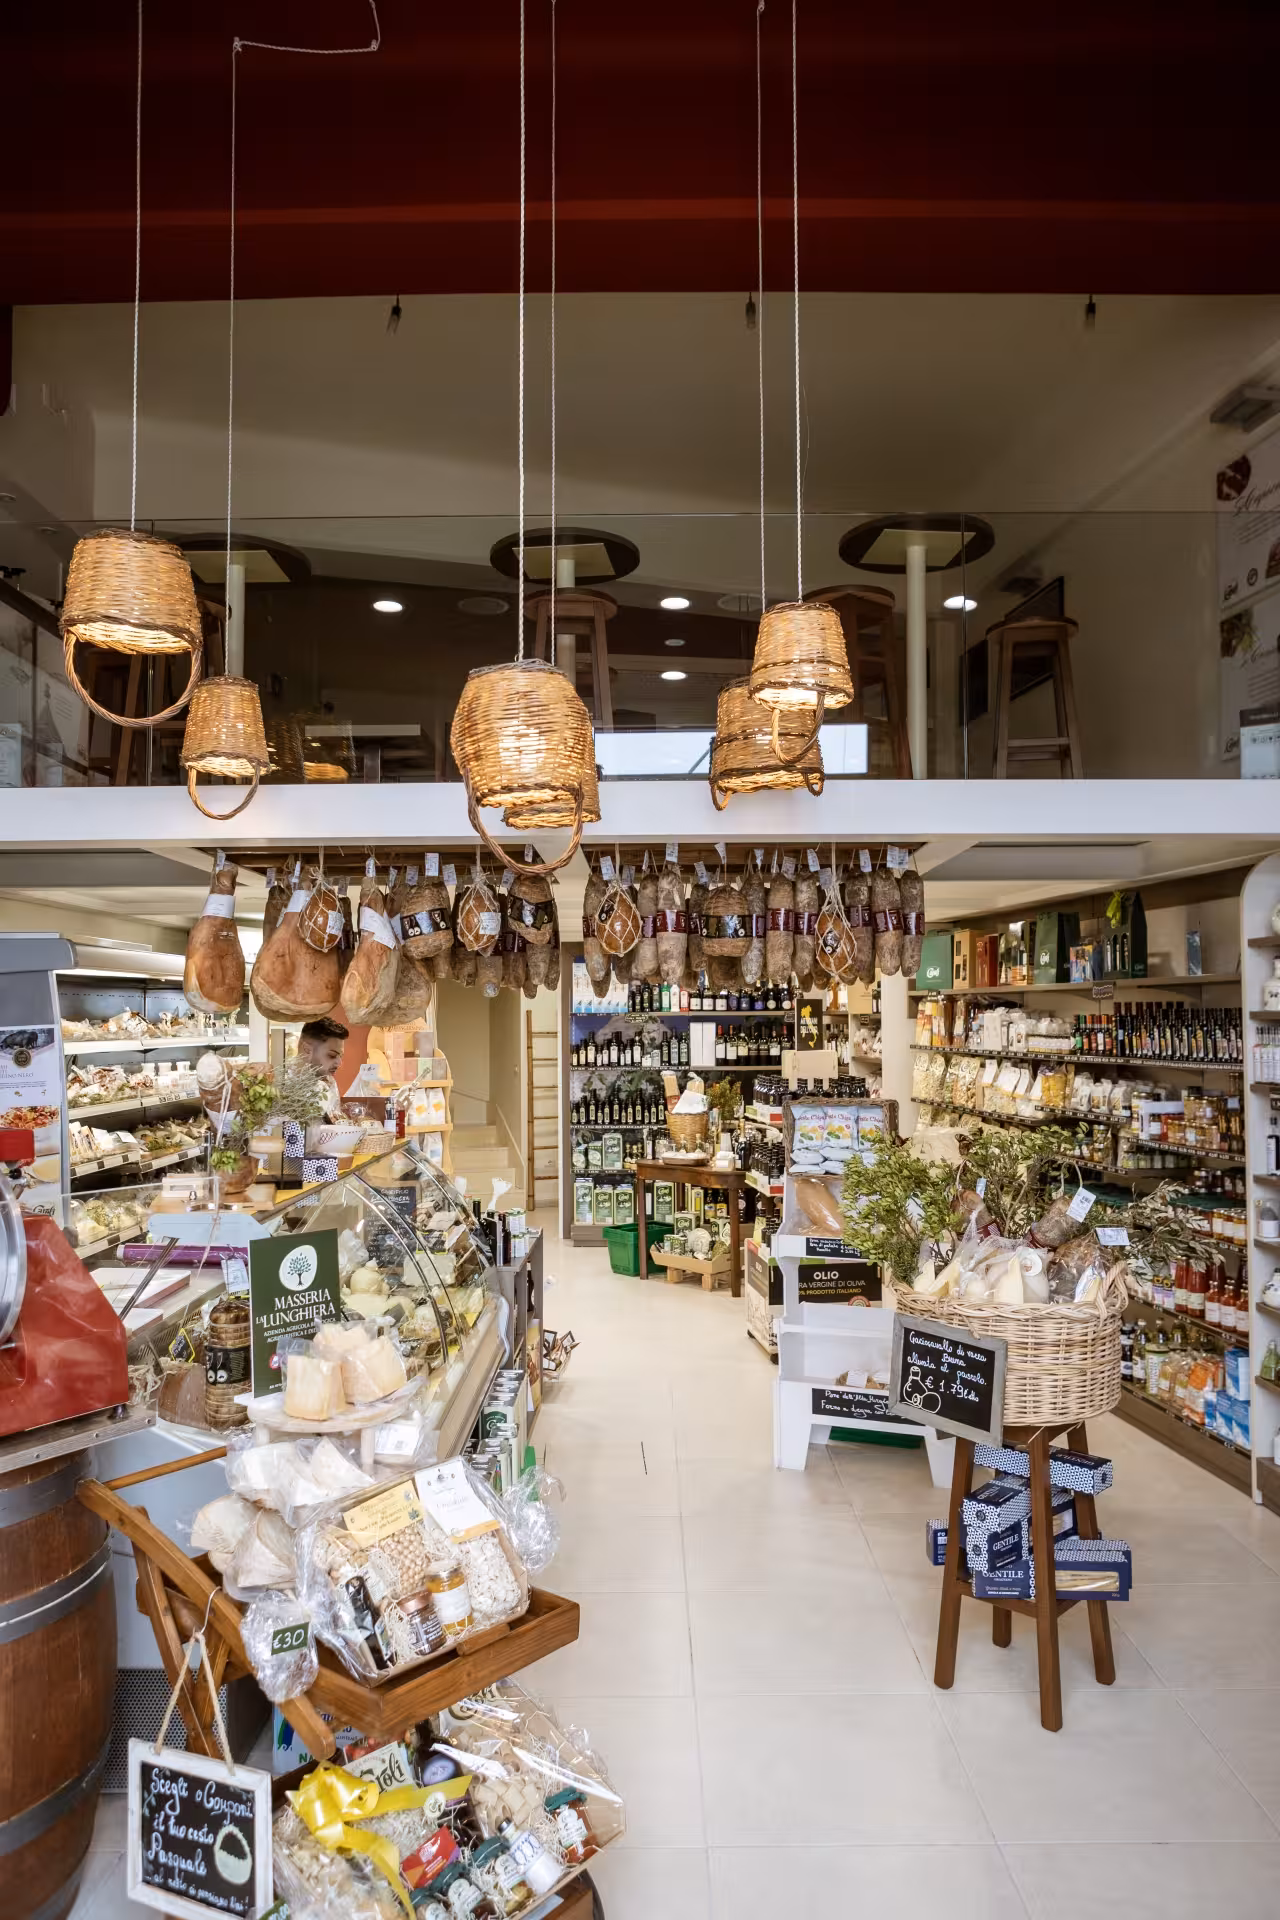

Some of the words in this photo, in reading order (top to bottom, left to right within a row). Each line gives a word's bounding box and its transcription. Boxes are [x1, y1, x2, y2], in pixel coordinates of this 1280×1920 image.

[814, 1271, 839, 1280] OLIO
[274, 1288, 331, 1310] MASSERIA
[256, 1316, 264, 1324] LA
[263, 1302, 336, 1328] LUNGHIERA
[264, 1327, 285, 1336] AZIENDA
[286, 1322, 310, 1332] AGRICOLA
[910, 1331, 953, 1353] Caciocavallo
[957, 1345, 965, 1356] di
[967, 1350, 986, 1362] vacca
[925, 1376, 934, 1388] €
[821, 1400, 840, 1410] Forno
[993, 1534, 1019, 1551] GENTILE
[151, 1768, 188, 1815] Scegli
[196, 1789, 202, 1802] o
[154, 1812, 165, 1830] il
[168, 1816, 186, 1837] tuo
[187, 1824, 214, 1843] cesto
[148, 1832, 207, 1880] Pasquale
